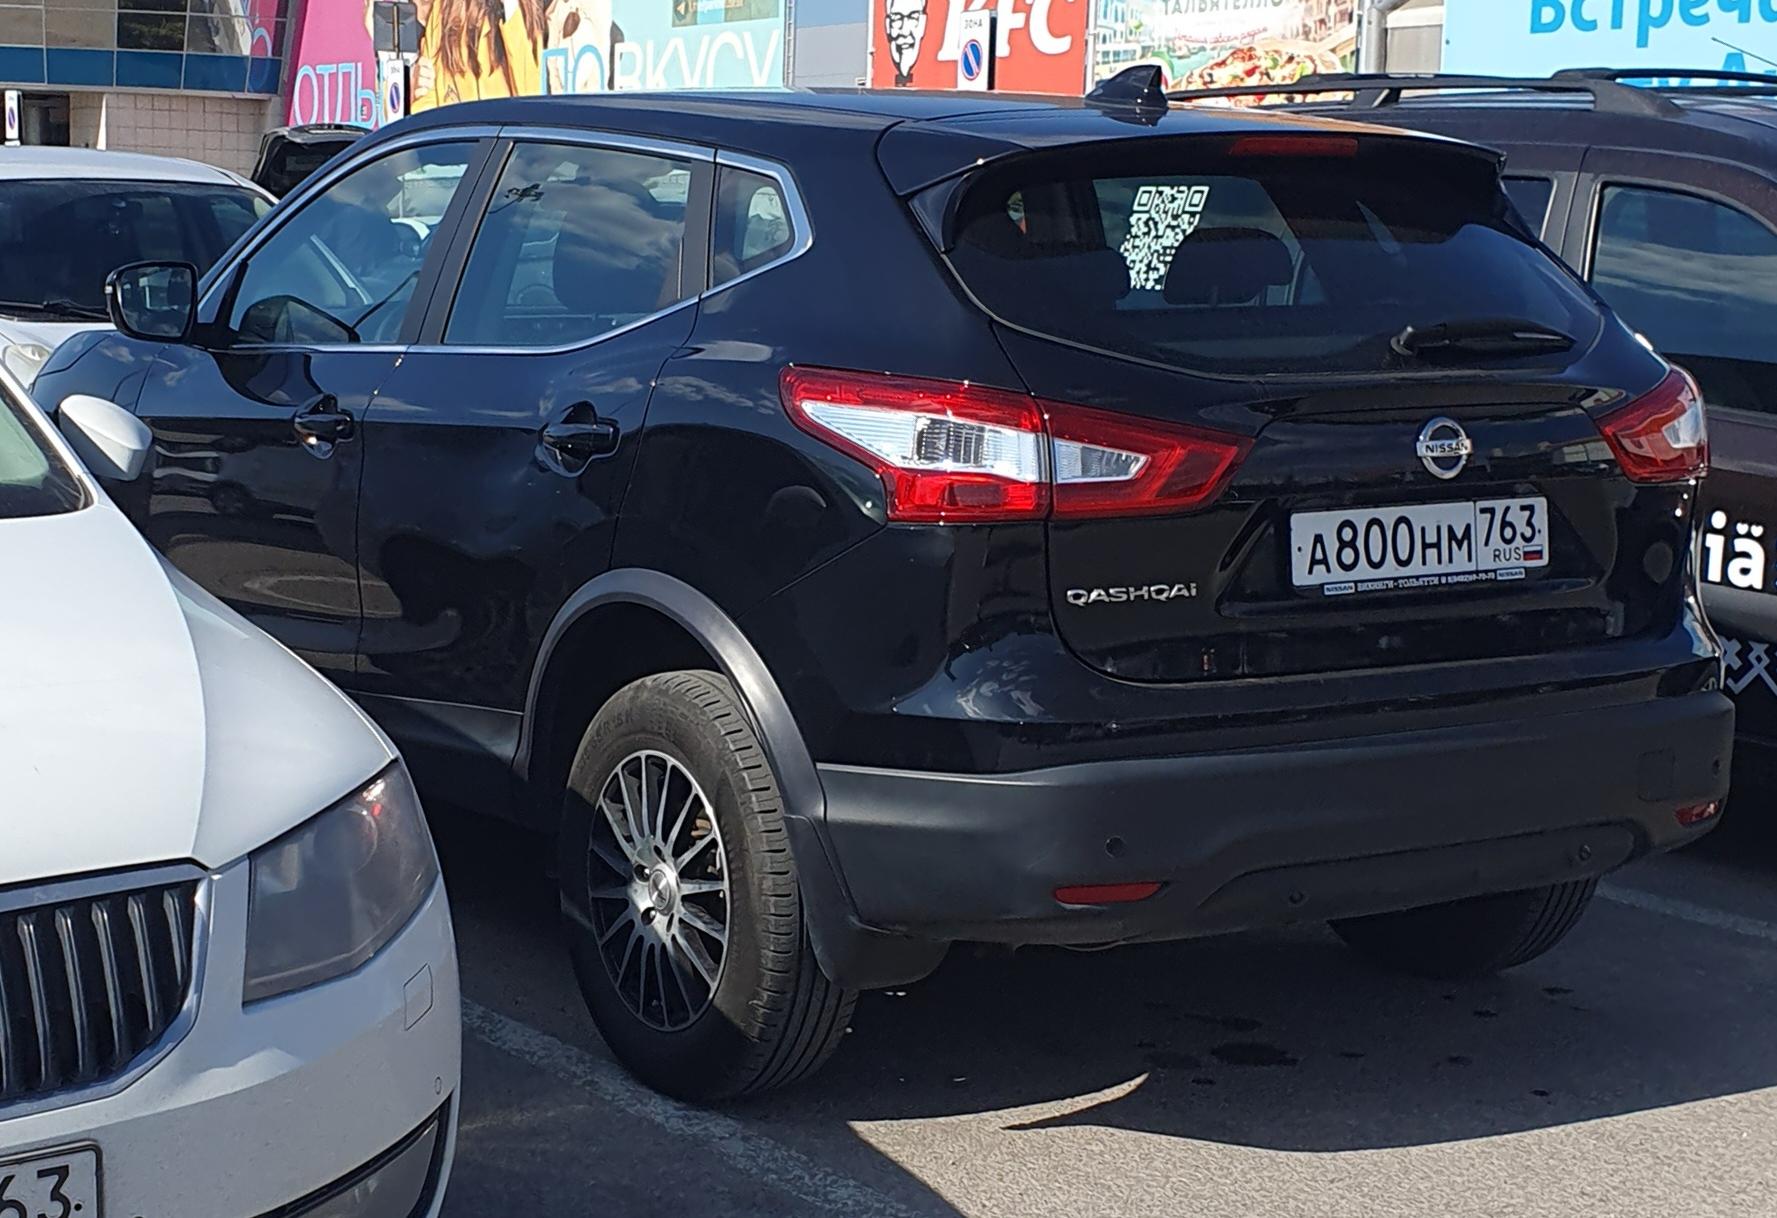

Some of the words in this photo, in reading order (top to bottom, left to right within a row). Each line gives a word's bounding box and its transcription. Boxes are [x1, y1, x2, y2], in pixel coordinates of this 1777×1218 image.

[1425, 442, 1469, 454] NISSAN
[1479, 504, 1536, 547] 763
[1493, 547, 1522, 562] RUS
